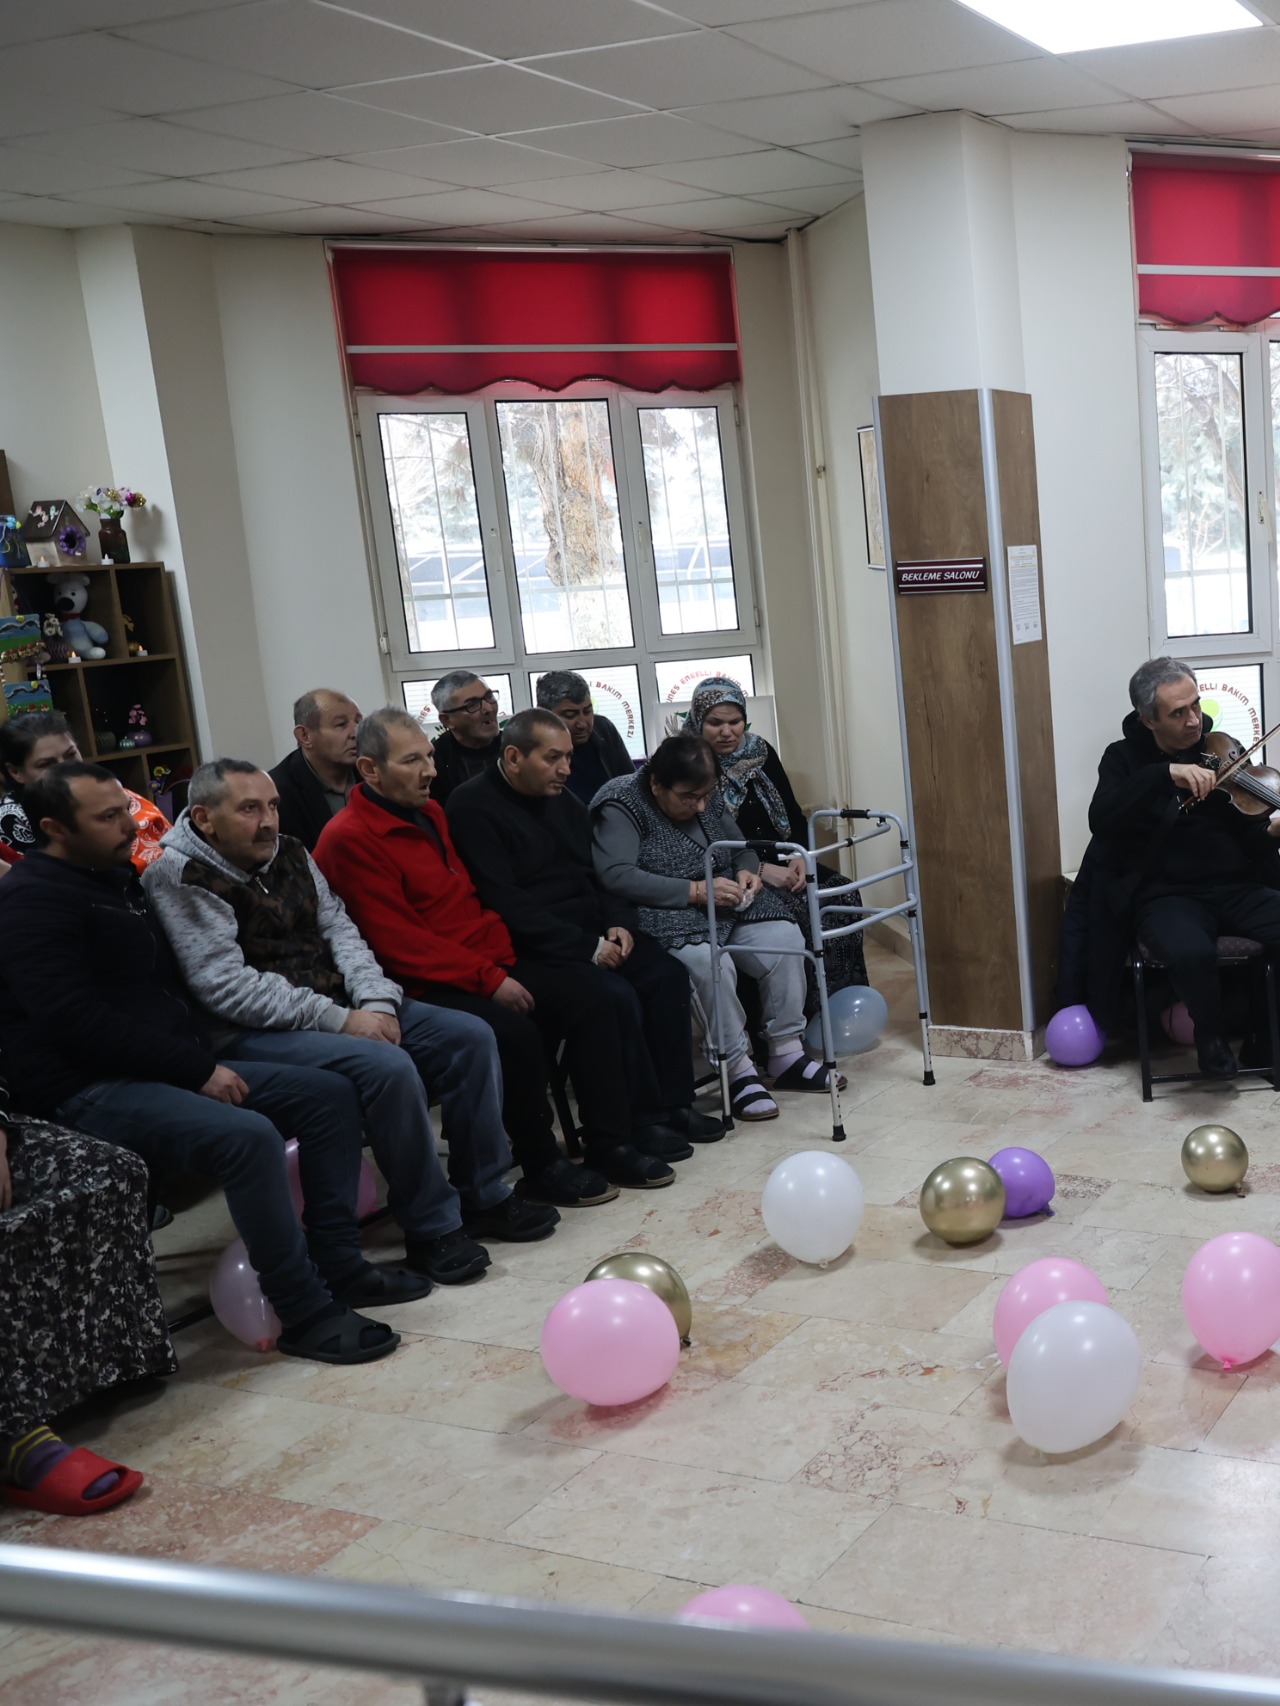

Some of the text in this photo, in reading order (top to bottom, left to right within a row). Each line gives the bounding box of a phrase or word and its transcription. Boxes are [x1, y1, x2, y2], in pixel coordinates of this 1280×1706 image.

[901, 570, 980, 581] BEKLEME SALONU
[595, 681, 623, 700] BAKIM
[1199, 682, 1261, 745] ELLI BAKIM MERKE
